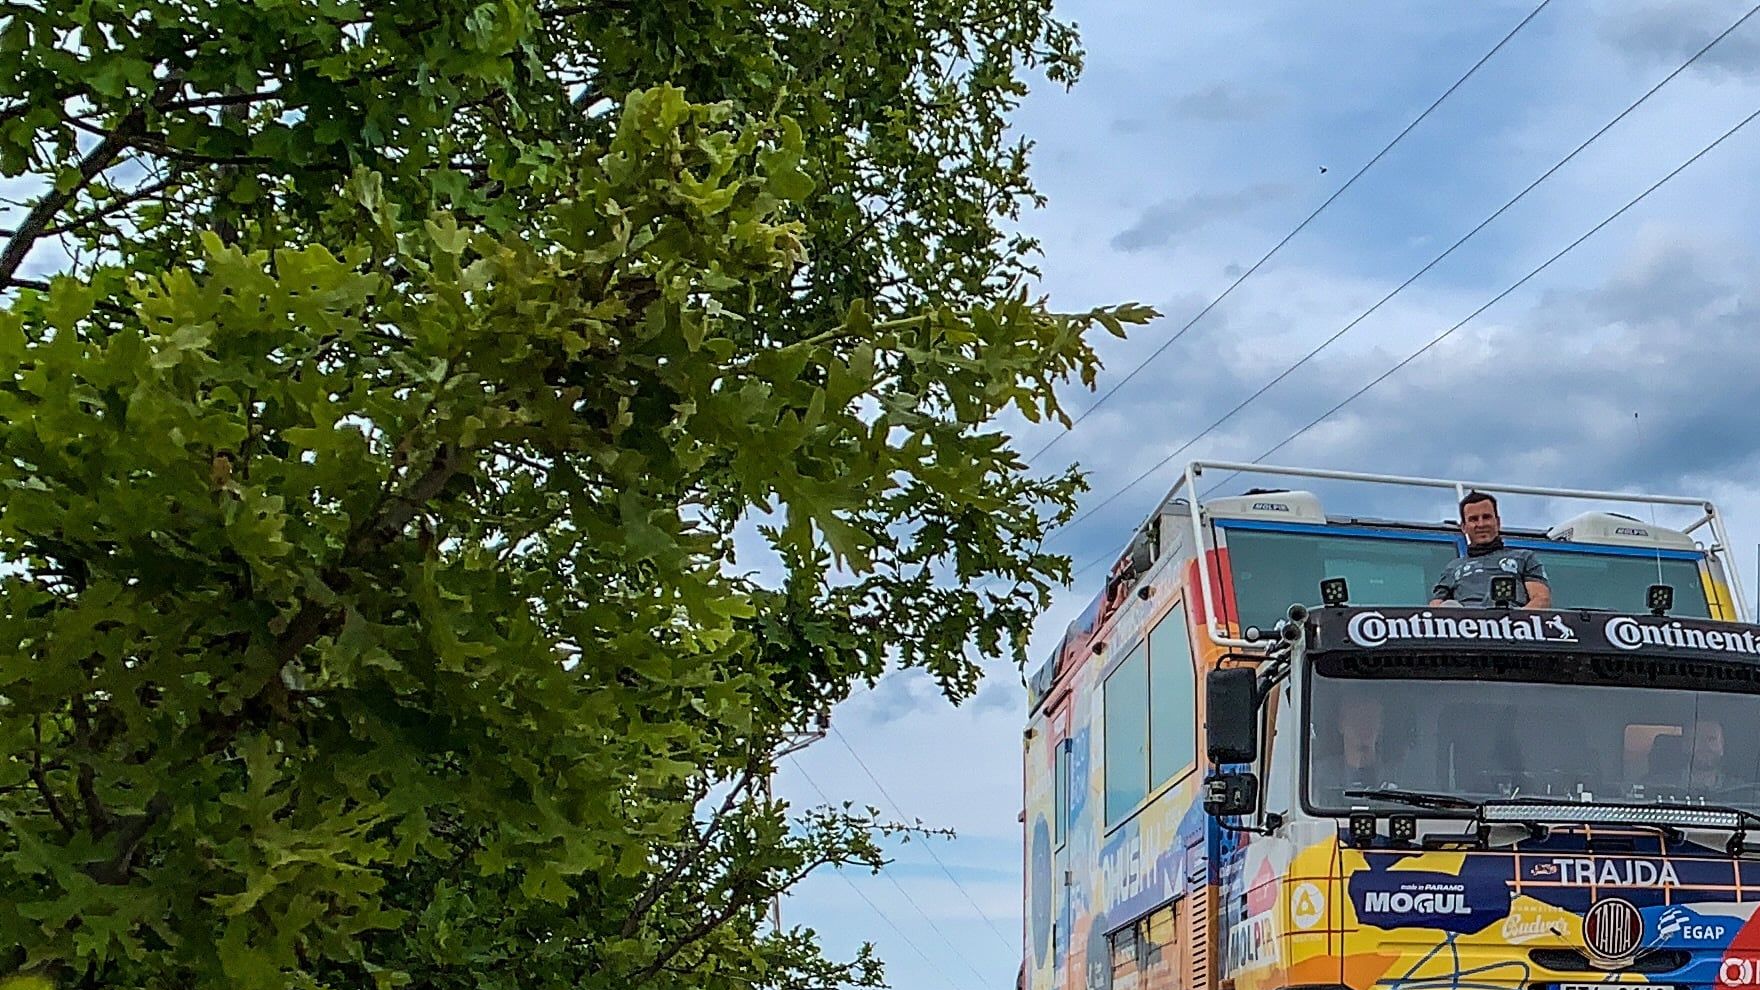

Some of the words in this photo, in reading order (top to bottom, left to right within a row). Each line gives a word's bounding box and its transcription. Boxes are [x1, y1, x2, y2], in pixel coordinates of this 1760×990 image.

[1348, 611, 1546, 647] Continental
[1553, 859, 1681, 887] TRAJDA
[1365, 892, 1471, 914] MOGUL
[1594, 903, 1631, 953] TATRA
[1683, 926, 1724, 939] EGAP
